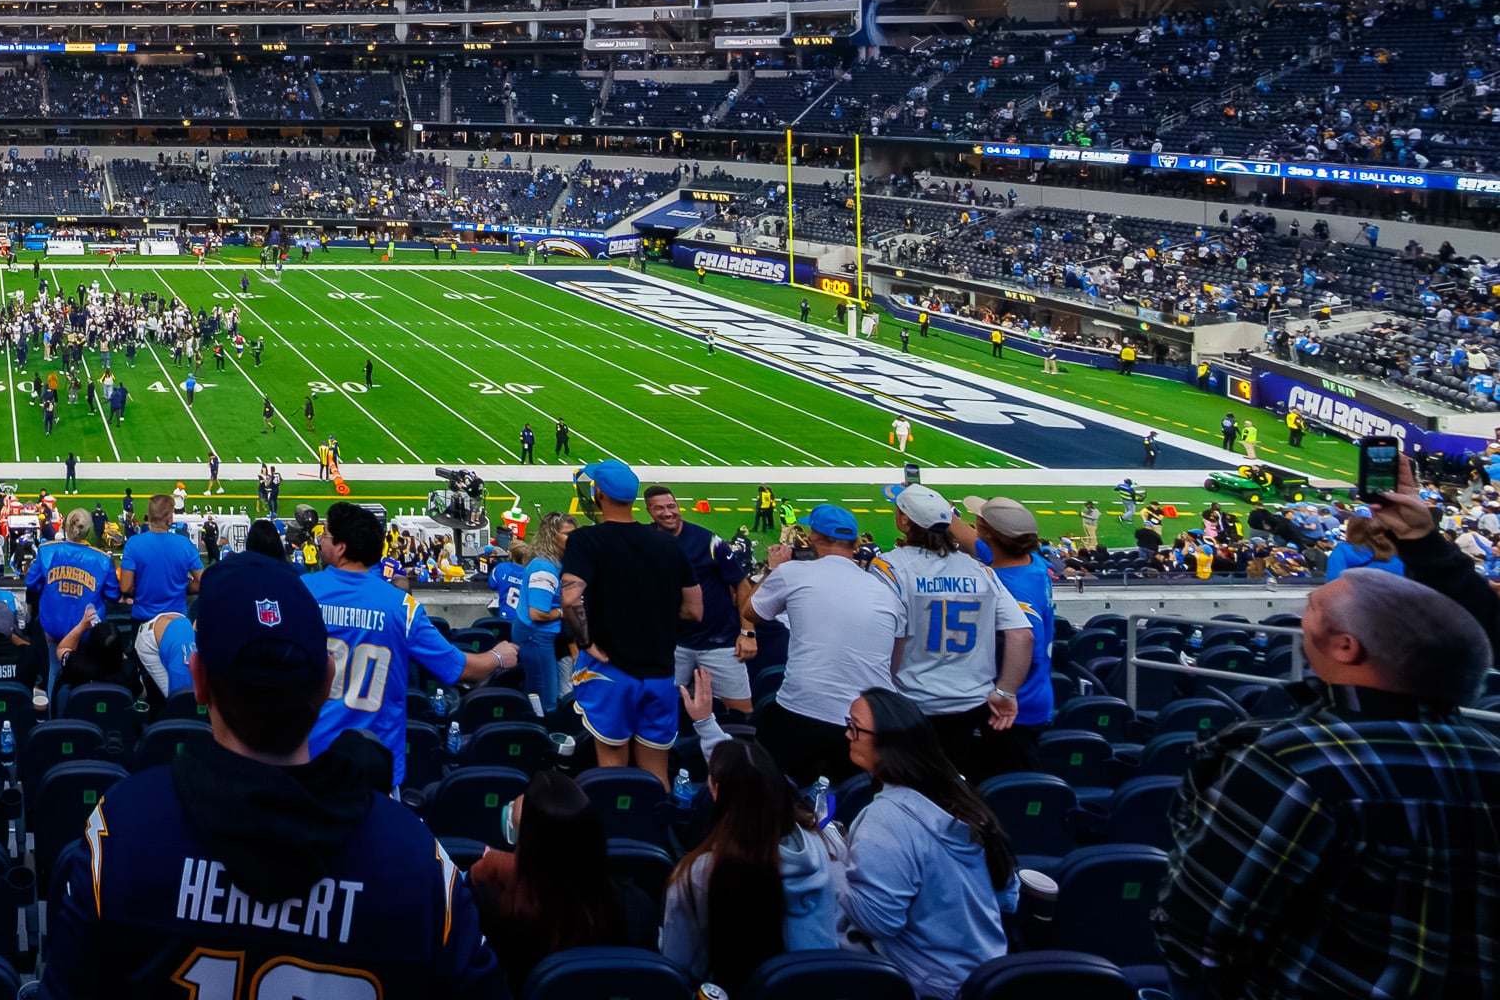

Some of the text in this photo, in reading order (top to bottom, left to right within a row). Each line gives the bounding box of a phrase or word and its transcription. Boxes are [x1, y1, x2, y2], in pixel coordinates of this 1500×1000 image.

[793, 37, 833, 45] WE WIN
[1254, 163, 1271, 173] 31
[1315, 168, 1329, 178] &
[1331, 169, 1350, 180] 12
[1359, 172, 1388, 184] BALL
[1388, 174, 1406, 185] ON
[1406, 175, 1424, 186] 39
[692, 191, 730, 202] WE WIN
[694, 251, 786, 281] CHARGERS
[822, 277, 850, 295] 0:00
[1004, 290, 1036, 303] WE WIN
[556, 280, 1086, 429] CHARGERS
[307, 381, 371, 394] 30
[468, 381, 534, 395] 20
[634, 382, 700, 396] 10
[1322, 378, 1356, 398] WE WIN
[1288, 386, 1406, 452] CHARGERS
[508, 523, 519, 535] G
[47, 565, 97, 592] CHARGERS
[506, 587, 521, 610] 6
[924, 599, 982, 654] 15
